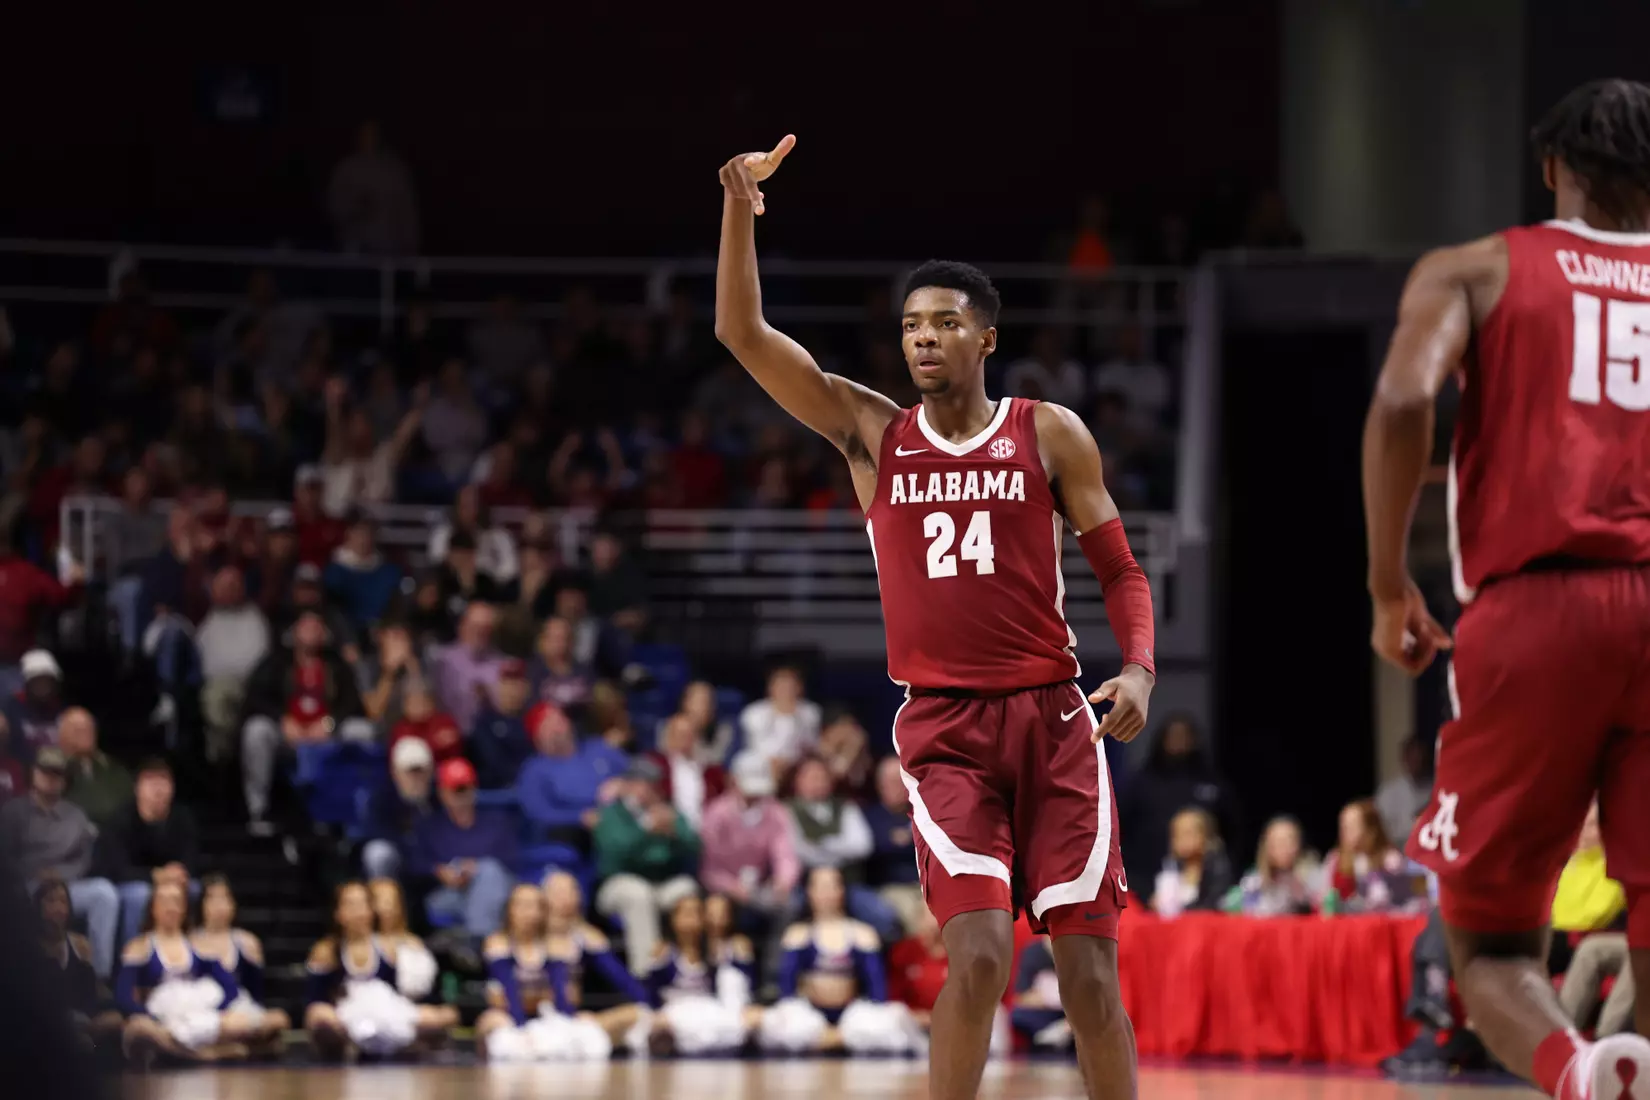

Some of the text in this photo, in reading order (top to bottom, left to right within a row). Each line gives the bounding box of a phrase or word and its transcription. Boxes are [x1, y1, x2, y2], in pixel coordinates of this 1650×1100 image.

[1569, 290, 1650, 411] 15
[990, 438, 1014, 459] SEC
[890, 470, 1026, 504] ALABAMA
[923, 510, 995, 579] 24
